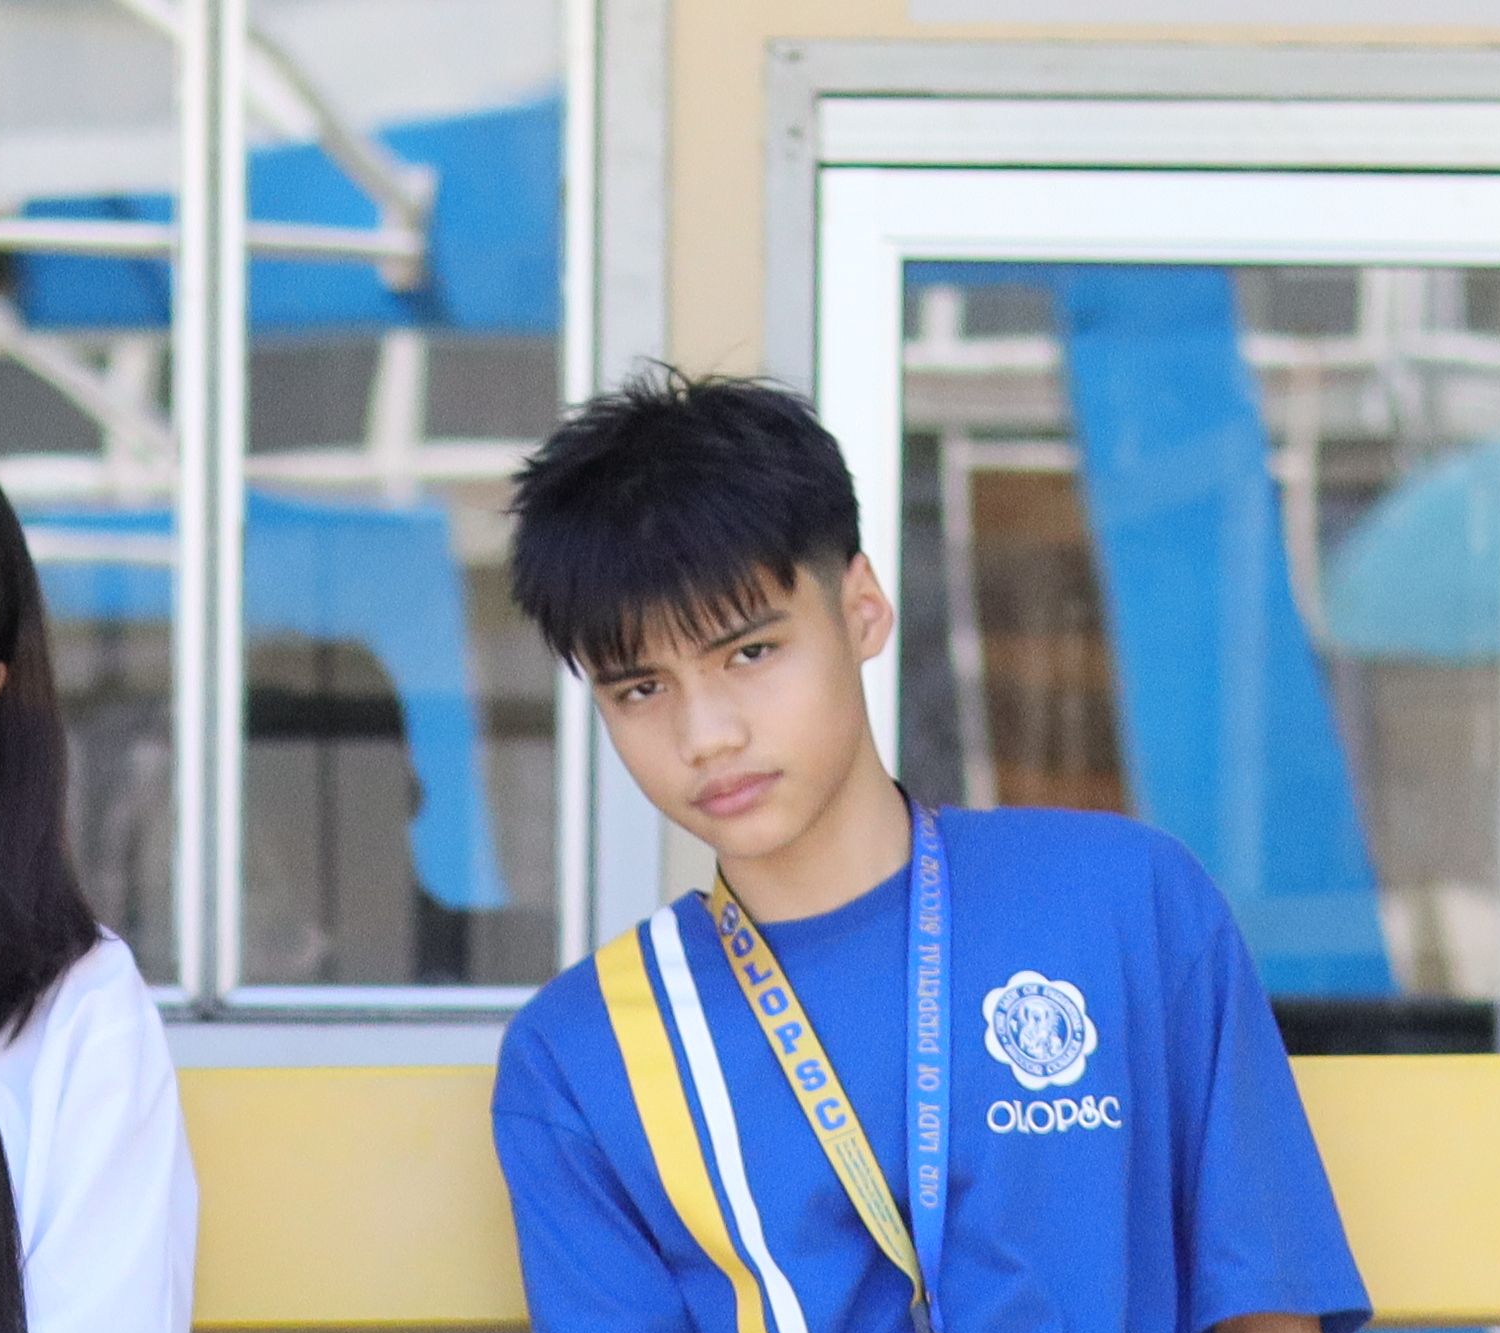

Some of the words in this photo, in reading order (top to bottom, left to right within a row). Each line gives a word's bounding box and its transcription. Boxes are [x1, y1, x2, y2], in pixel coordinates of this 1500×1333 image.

[917, 943, 941, 1053] PERPETUAL
[731, 928, 847, 1131] OLOPSC
[917, 1065, 941, 1091] OF
[918, 1101, 940, 1151] LADY
[919, 1164, 939, 1208] OUR
